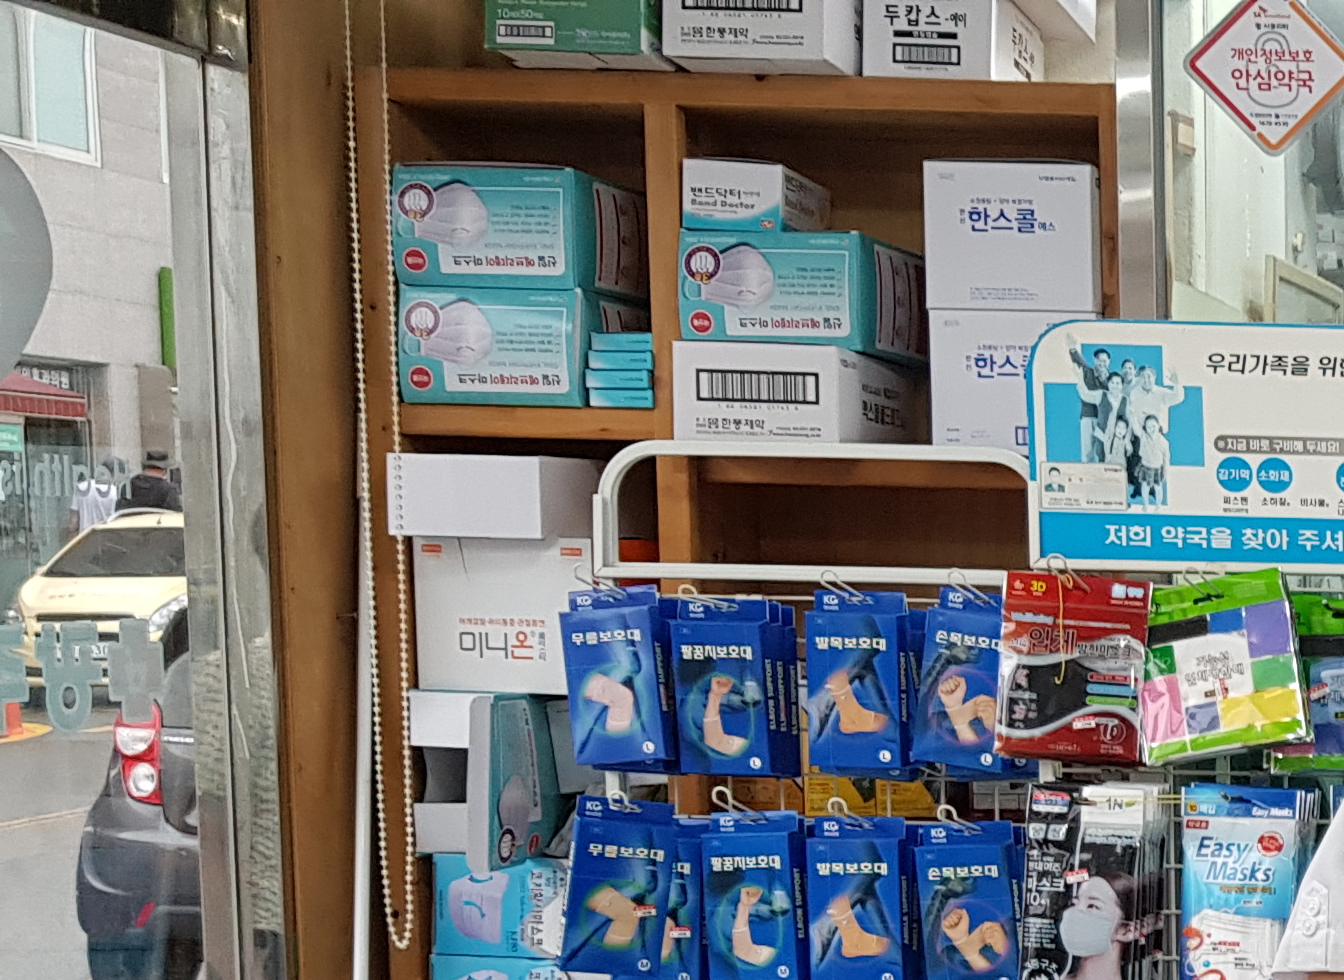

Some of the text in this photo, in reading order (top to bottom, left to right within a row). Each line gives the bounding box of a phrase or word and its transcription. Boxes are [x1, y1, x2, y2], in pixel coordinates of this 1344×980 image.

[1231, 47, 1314, 65] 개인정보보호
[1231, 68, 1314, 94] 안심약국
[690, 186, 742, 200] 밴드닥터
[452, 256, 483, 267] 마스크
[738, 317, 820, 329] 에브리데이 마스크
[974, 352, 1027, 381] 한스
[1206, 353, 1311, 377] 우리가족을
[458, 373, 487, 386] 마스크
[1226, 438, 1340, 453] 지금 바로 구비해 두세요!
[1218, 469, 1291, 483] 감기약 소화제
[1105, 523, 1151, 549] 저희
[1161, 525, 1233, 551] 약국을
[1242, 528, 1289, 553] 찾아
[1030, 580, 1047, 592] 3D
[459, 629, 535, 662] 미니온
[571, 629, 641, 647] 무릎보호대
[815, 636, 886, 652] 발목보호대
[681, 644, 753, 661] 팔꿈치보호대
[587, 843, 664, 862] 무릎보호대
[1195, 836, 1253, 860] Easy
[710, 854, 781, 870] 팔꿈치보호대
[816, 860, 888, 877] 발목보호대
[927, 864, 998, 880] 손목보호대
[1204, 861, 1275, 884] Masks
